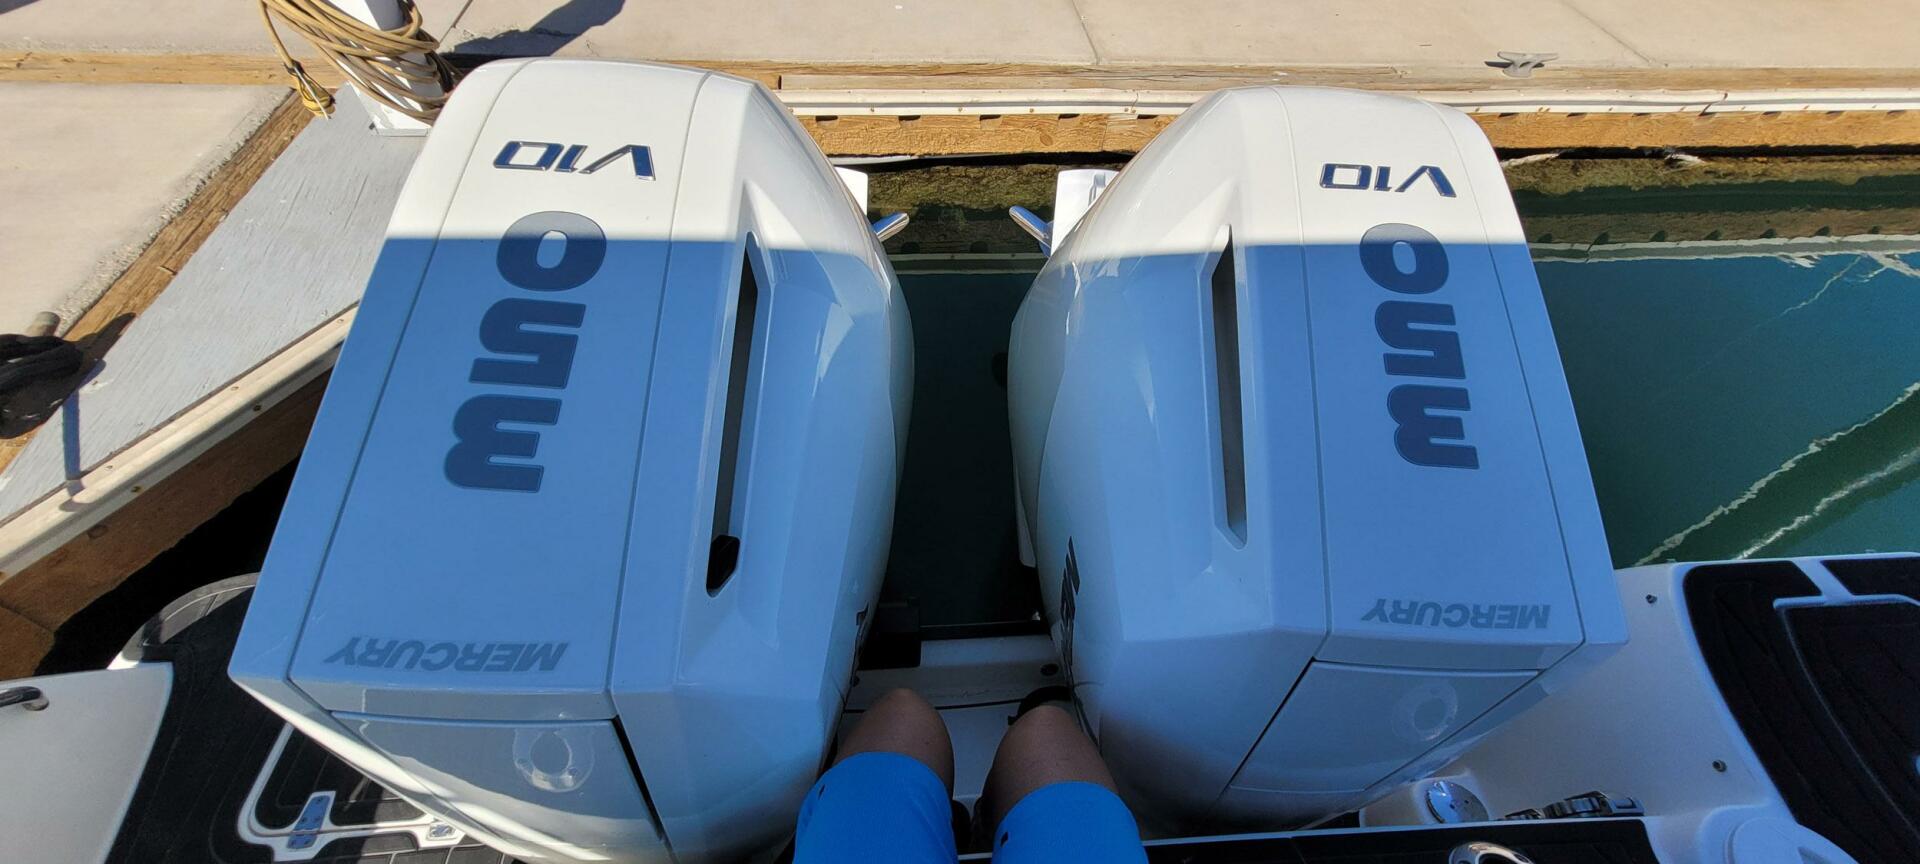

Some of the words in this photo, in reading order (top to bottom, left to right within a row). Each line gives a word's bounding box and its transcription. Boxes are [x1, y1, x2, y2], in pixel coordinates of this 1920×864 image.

[493, 140, 656, 181] V10
[1320, 163, 1457, 198] V10
[443, 210, 607, 493] 350
[1359, 222, 1480, 470] 350
[1360, 598, 1551, 630] MERCURY
[323, 636, 569, 672] MERCURY
